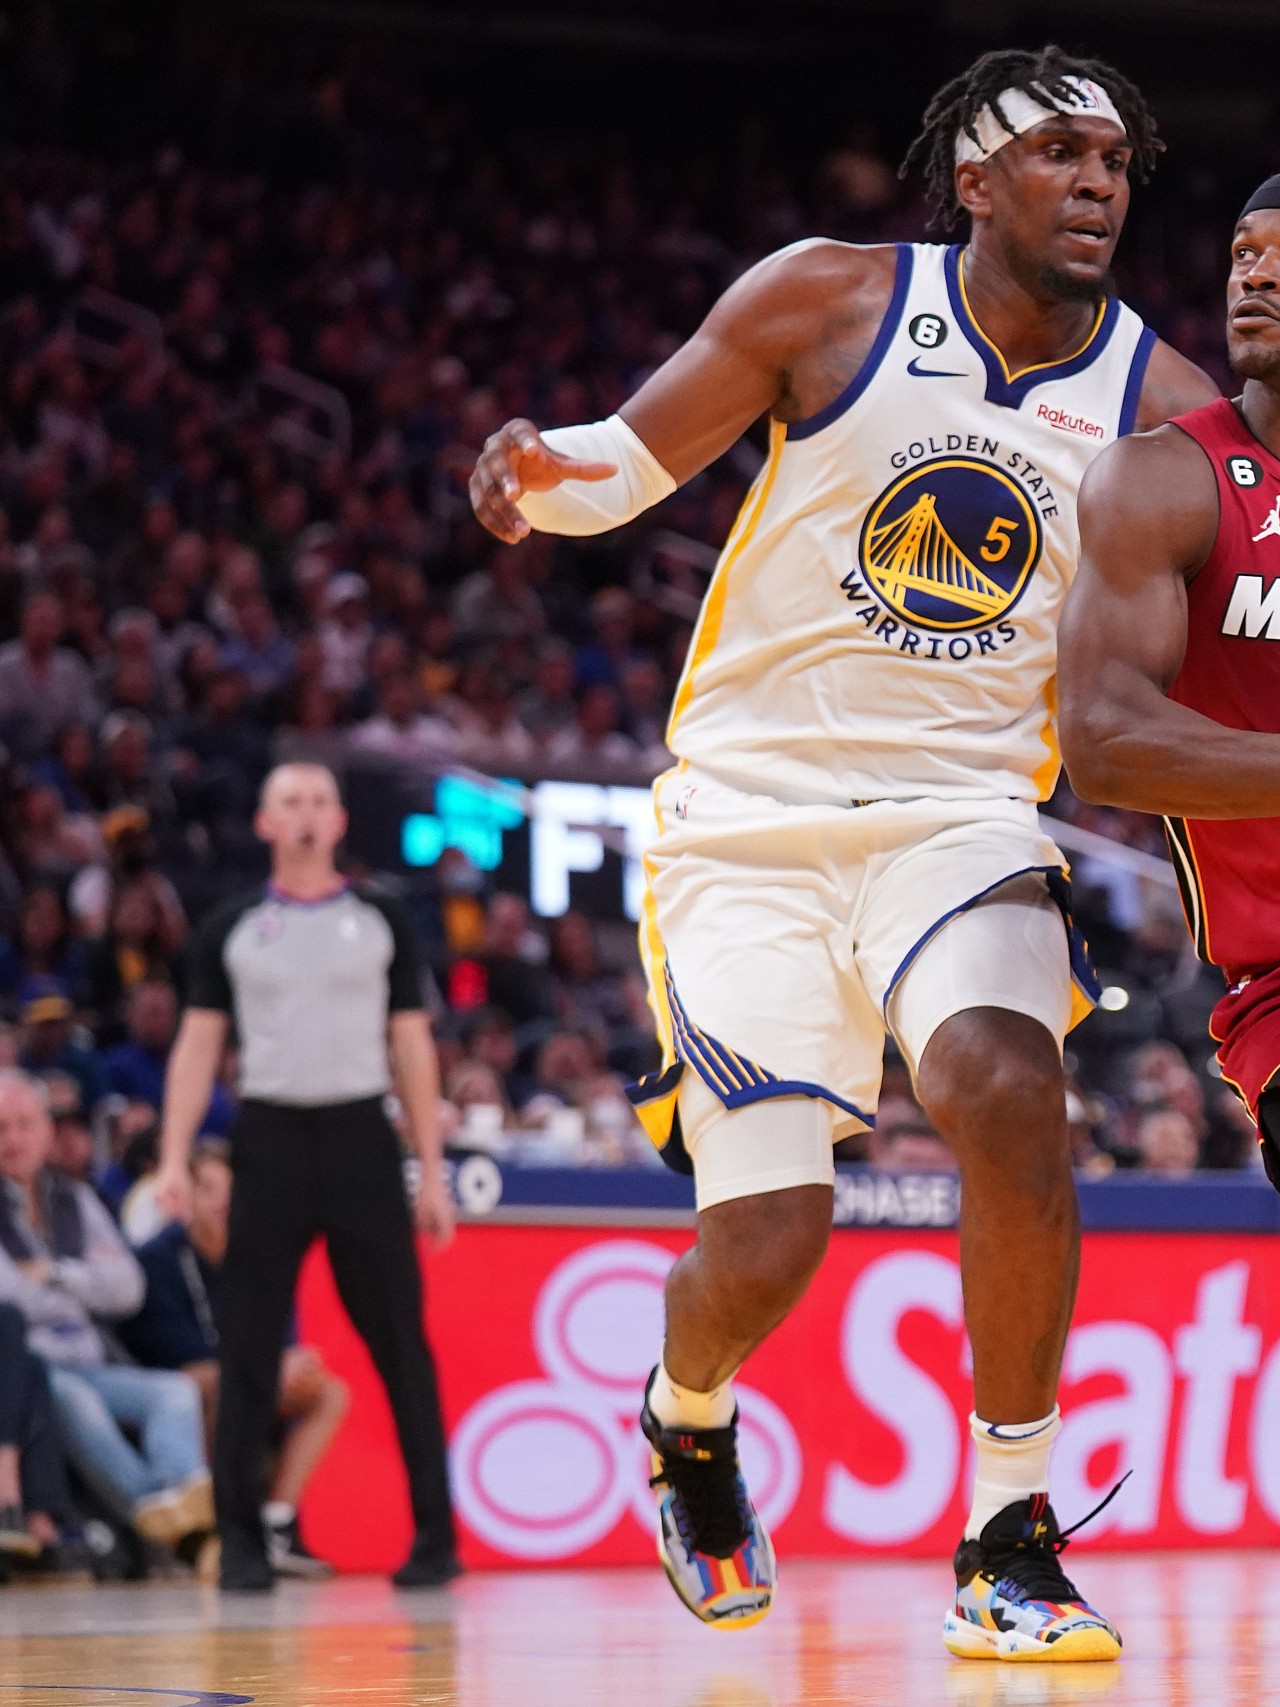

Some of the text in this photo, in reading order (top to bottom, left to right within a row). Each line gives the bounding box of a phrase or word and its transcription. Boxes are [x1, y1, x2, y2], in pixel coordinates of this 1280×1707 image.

[915, 316, 942, 347] 6
[1037, 404, 1104, 439] Rakuten
[890, 434, 1059, 520] GOLDEN STATE
[1230, 458, 1256, 486] 6
[979, 516, 1019, 563] 5
[839, 567, 1017, 661] WARRIORS
